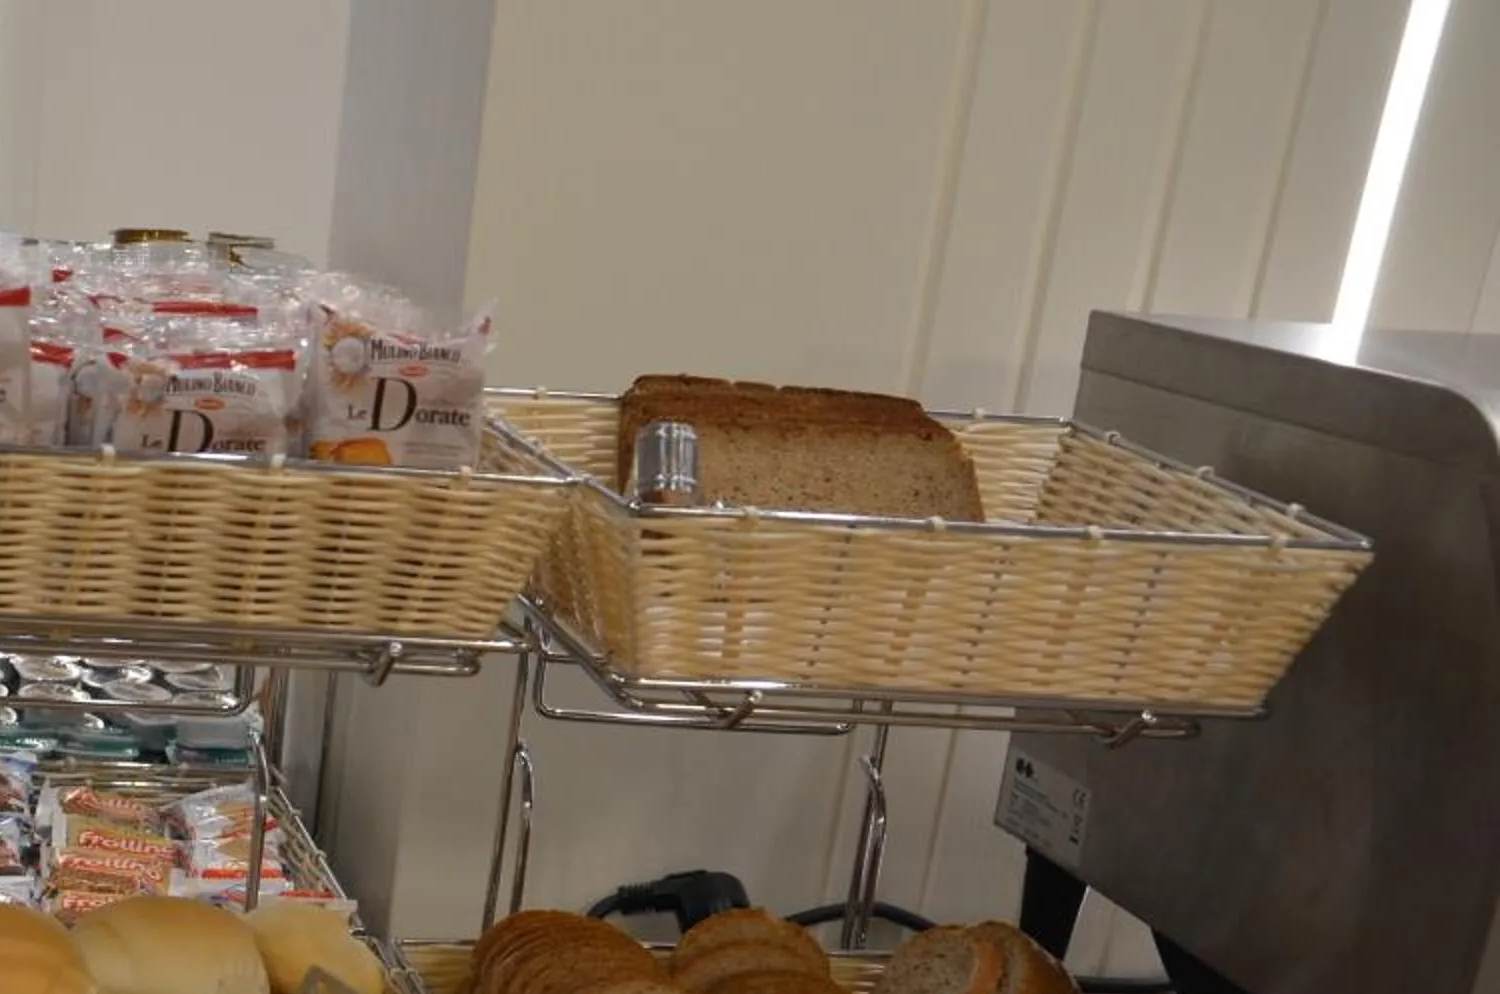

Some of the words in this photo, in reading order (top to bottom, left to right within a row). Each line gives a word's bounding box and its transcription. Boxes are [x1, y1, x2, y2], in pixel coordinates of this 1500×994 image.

[347, 404, 368, 421] Le
[367, 376, 472, 432] Dorate
[141, 434, 162, 449] Le
[164, 408, 267, 453] Dorate
